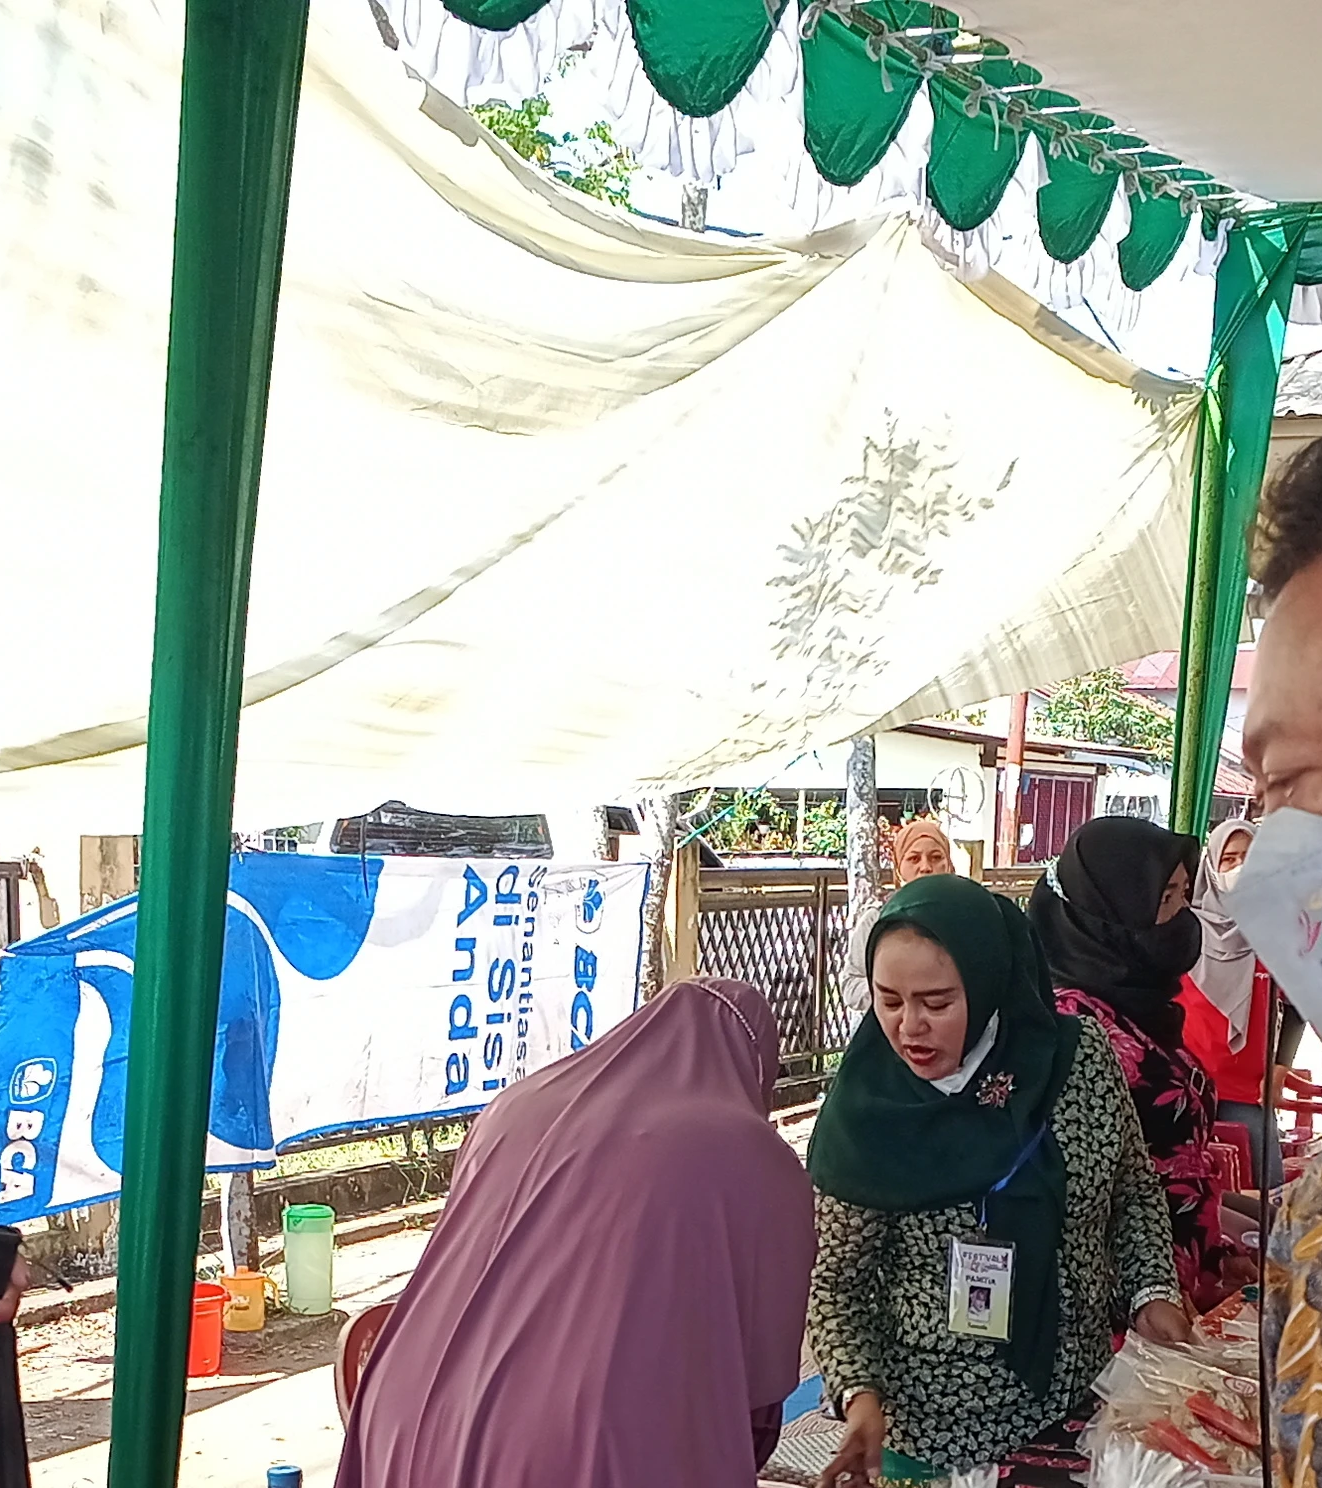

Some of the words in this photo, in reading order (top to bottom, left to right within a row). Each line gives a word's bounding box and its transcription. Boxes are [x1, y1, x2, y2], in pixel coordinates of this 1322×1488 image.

[444, 863, 489, 1096] Anda
[492, 864, 523, 927] di
[514, 864, 549, 1082] Senantiasa
[481, 957, 516, 1092] Sisi
